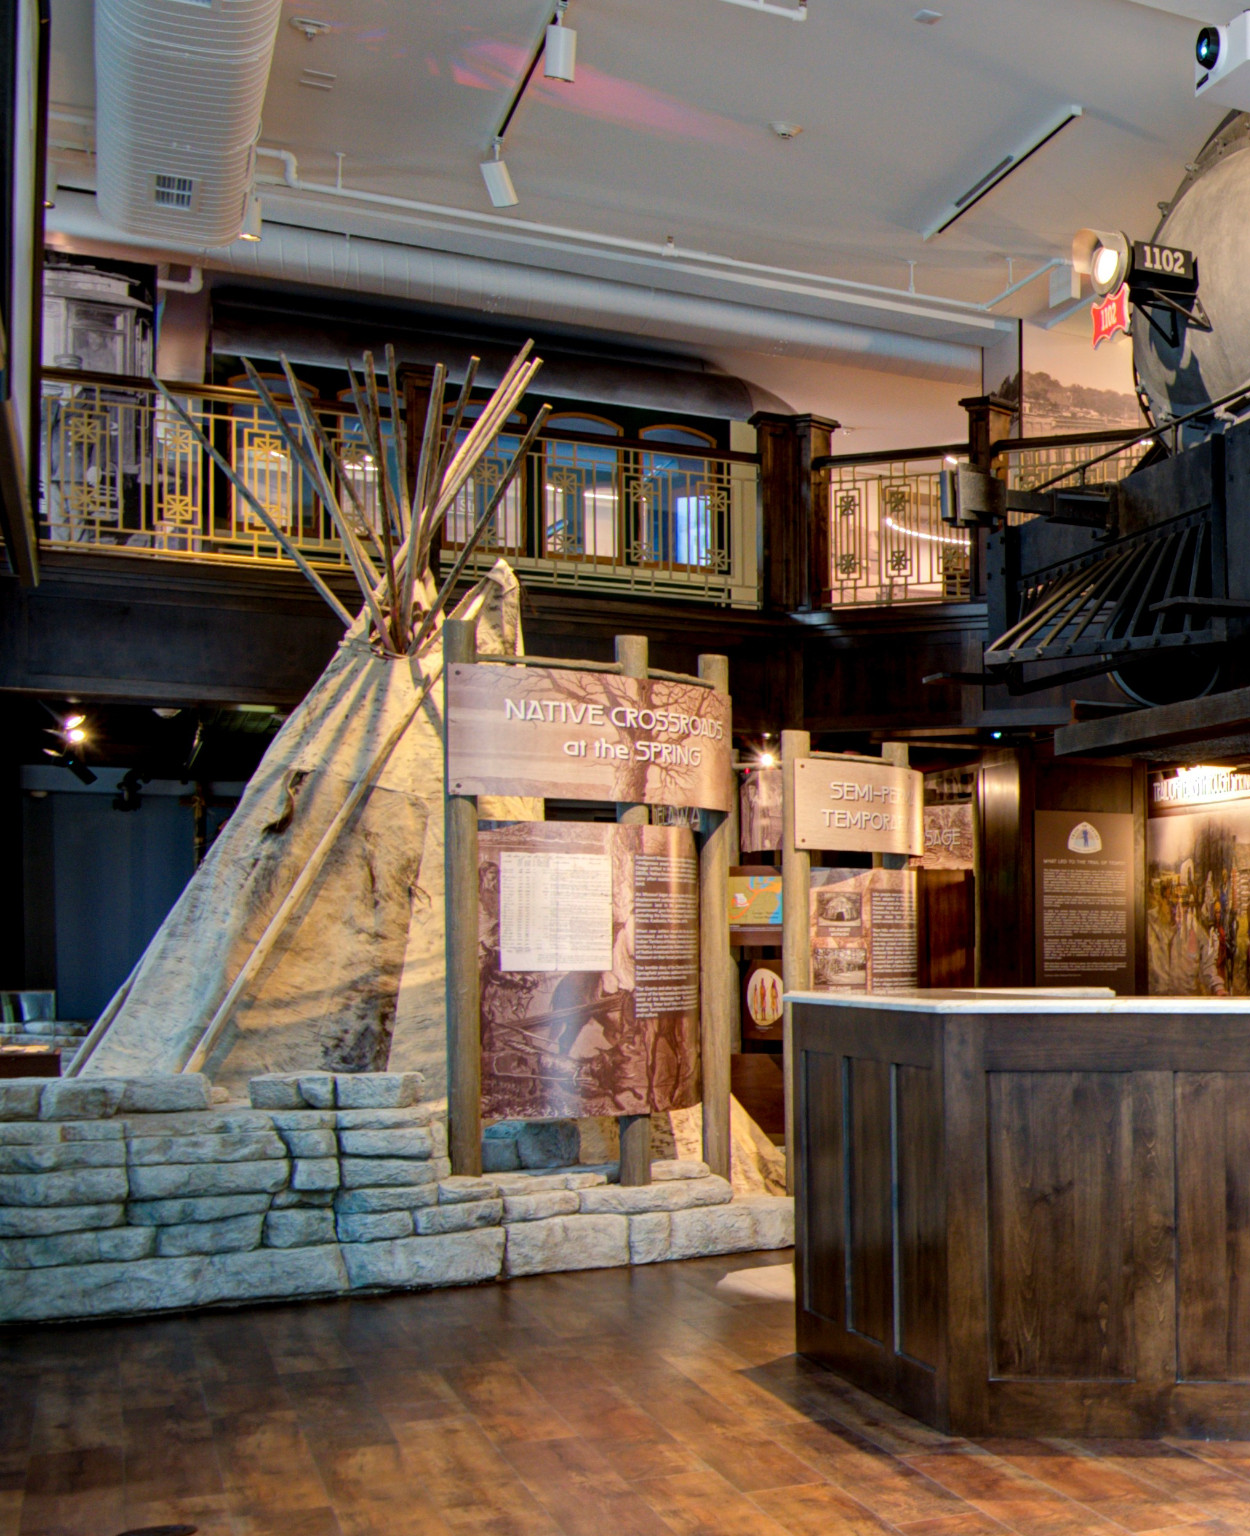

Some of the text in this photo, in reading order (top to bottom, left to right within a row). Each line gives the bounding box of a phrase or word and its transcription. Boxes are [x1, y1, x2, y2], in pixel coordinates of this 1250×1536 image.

[1143, 245, 1185, 274] 1102
[1101, 302, 1117, 332] 1102
[504, 698, 723, 740] NATIVE CROSSROADS
[563, 738, 701, 766] at the SPRING
